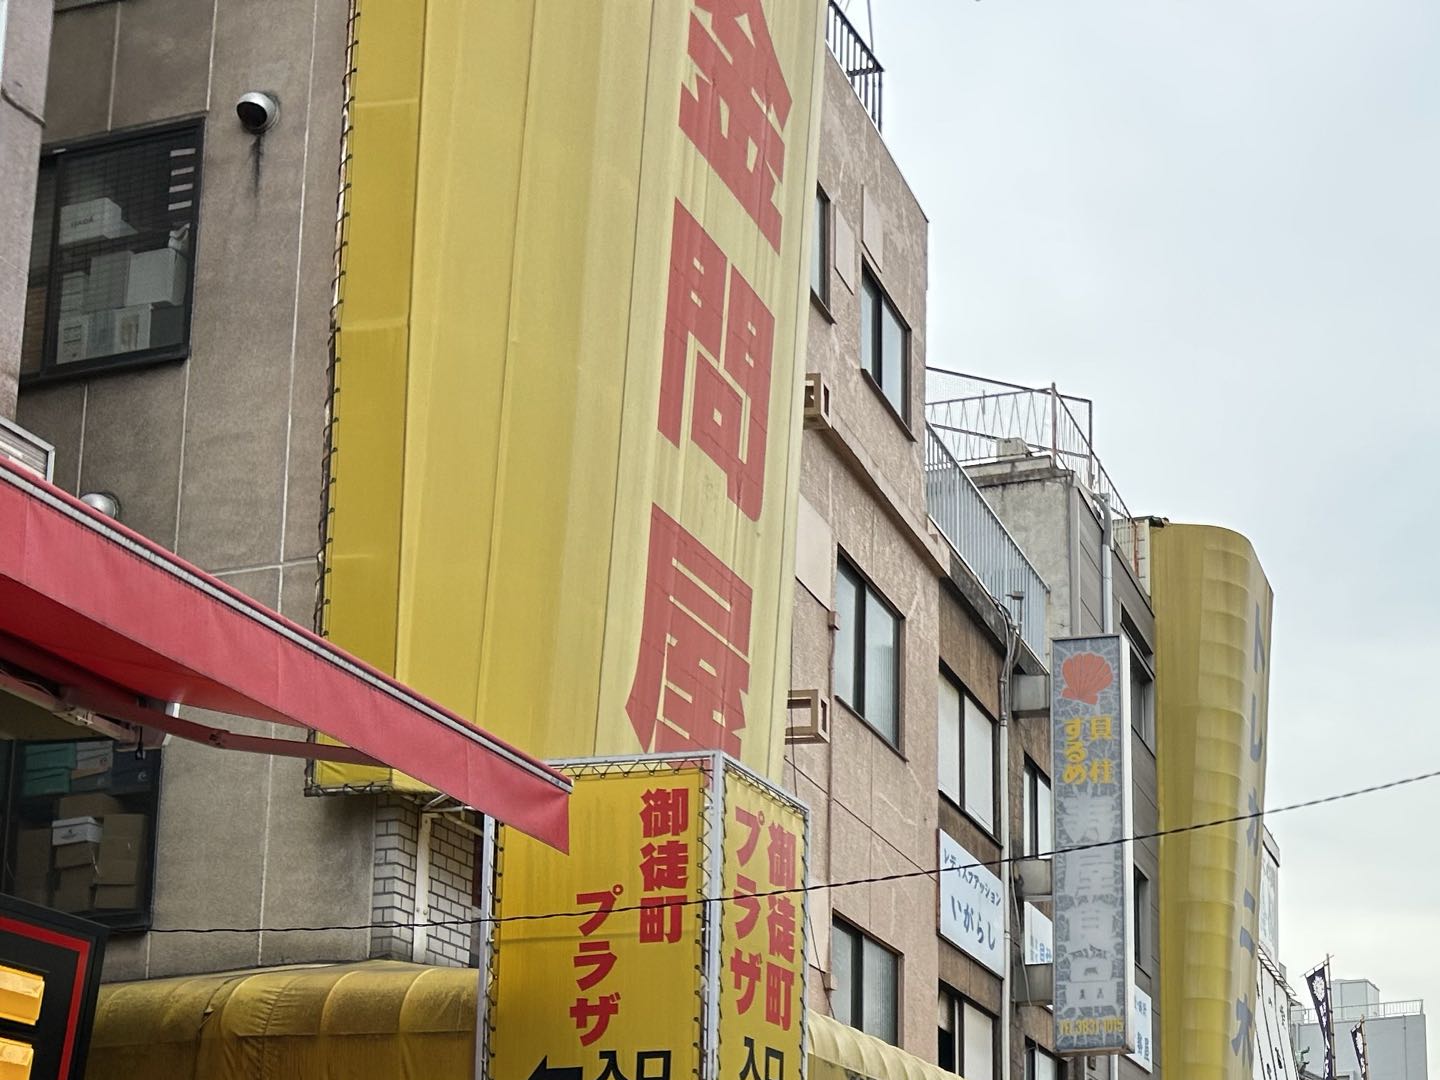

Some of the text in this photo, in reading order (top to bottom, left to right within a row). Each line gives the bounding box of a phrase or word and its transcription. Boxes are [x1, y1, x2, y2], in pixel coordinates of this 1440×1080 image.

[1062, 717, 1087, 785] するめ
[639, 788, 689, 944] 御徒町
[730, 806, 766, 1015] プラザ
[766, 821, 797, 1031] 御徒町
[951, 895, 996, 951] いがらし
[569, 884, 624, 1047] プラザ
